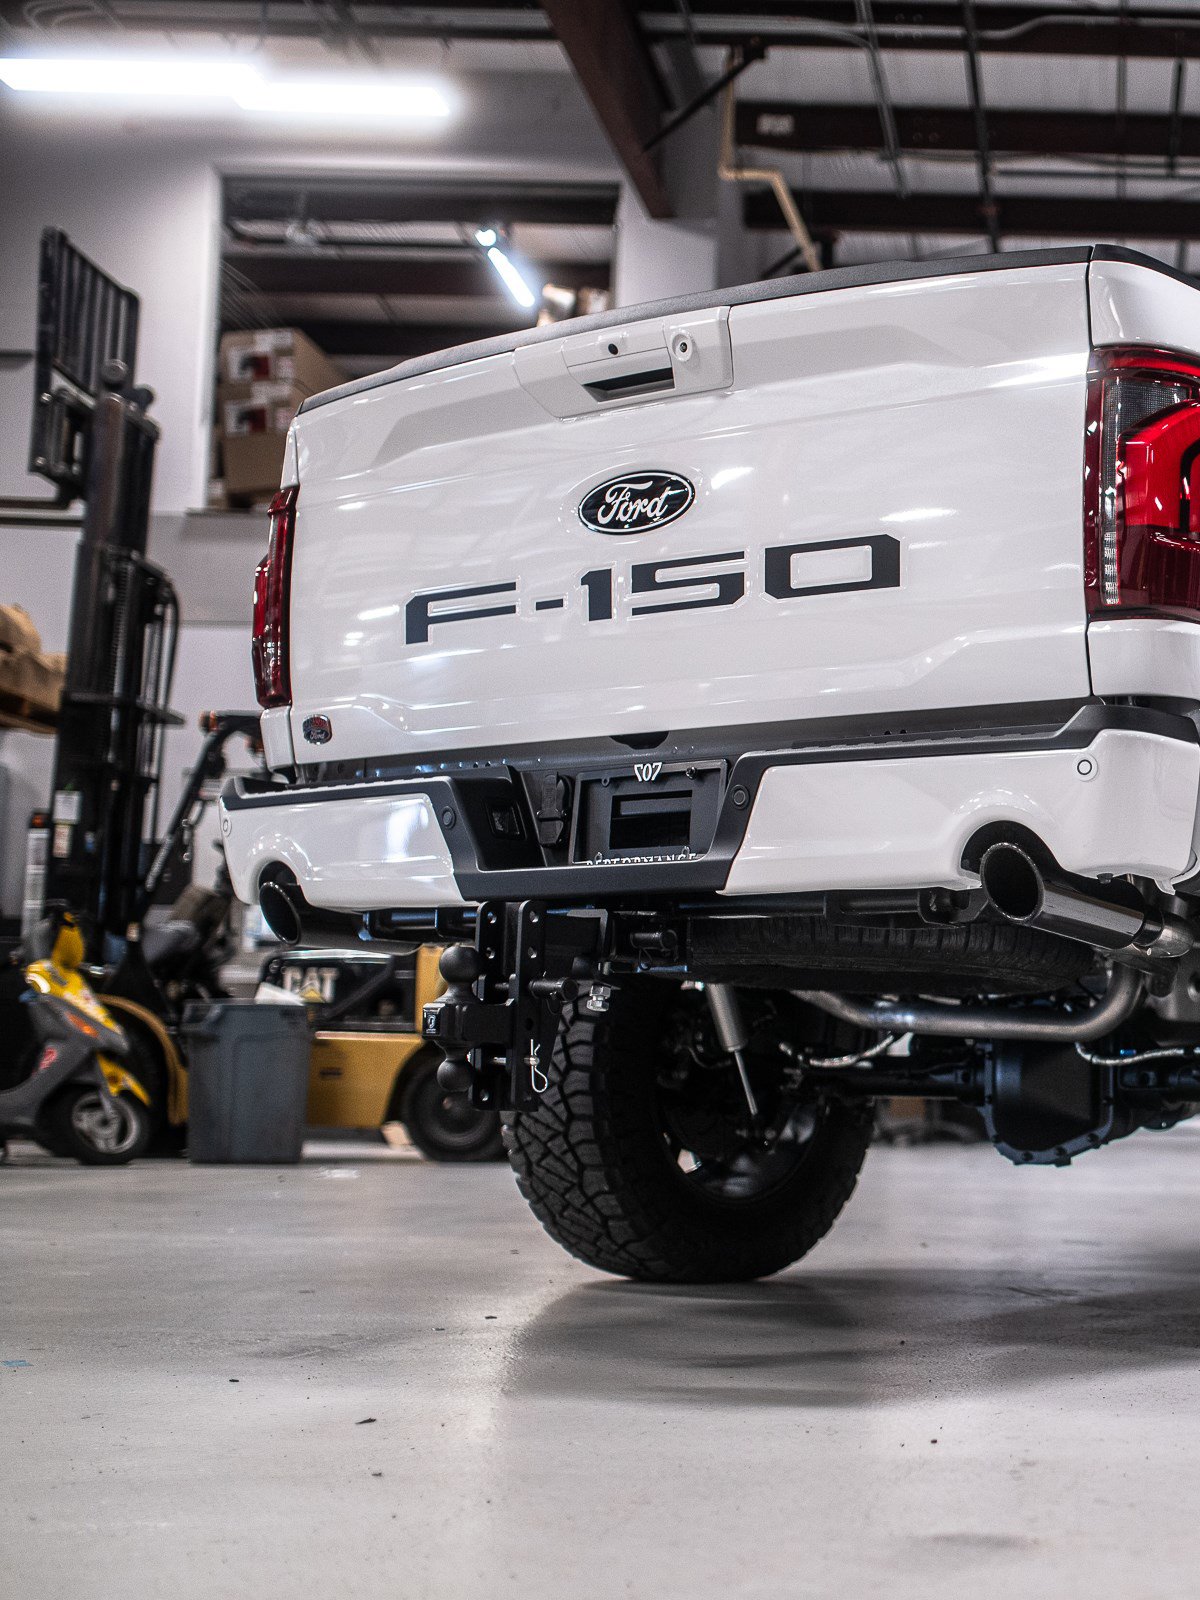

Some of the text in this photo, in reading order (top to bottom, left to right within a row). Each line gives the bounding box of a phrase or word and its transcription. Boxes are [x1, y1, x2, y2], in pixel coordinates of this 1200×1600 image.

[596, 479, 684, 526] Ford
[405, 533, 901, 645] F-150
[283, 966, 339, 1003] CAT
